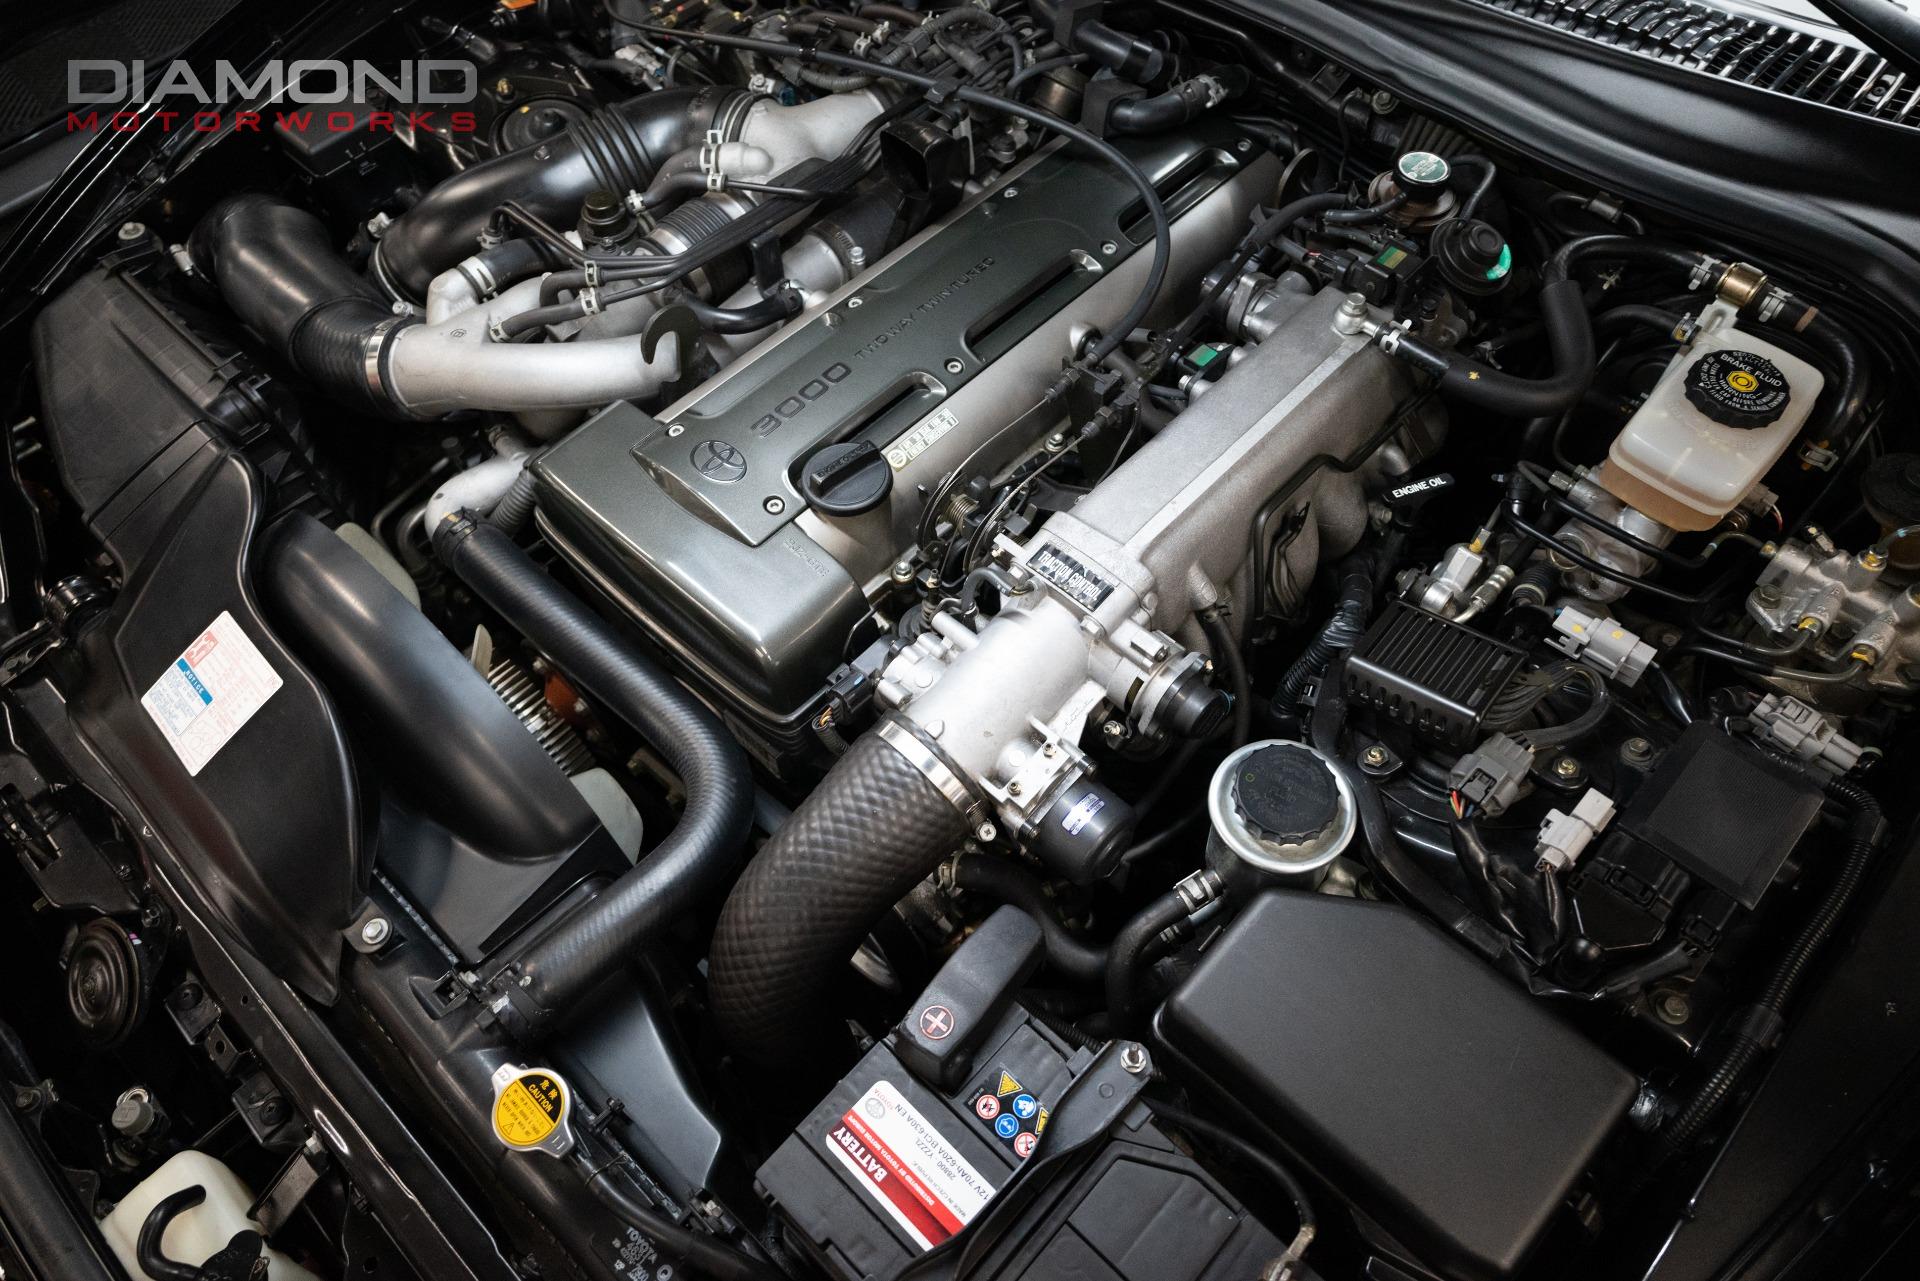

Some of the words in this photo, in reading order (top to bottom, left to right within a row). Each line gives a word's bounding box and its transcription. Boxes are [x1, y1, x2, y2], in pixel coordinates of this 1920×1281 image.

[750, 361, 852, 438] 3000
[918, 288, 951, 314] TWIN
[950, 255, 995, 291] TURBO
[1720, 353, 1753, 372] BRAKE
[1754, 370, 1782, 386] FLUID
[1392, 481, 1430, 498] ENGINE
[1428, 477, 1447, 488] OIL
[1038, 550, 1073, 579] TRACTION
[1069, 572, 1102, 600] CONTROL
[184, 669, 204, 695] NOTICE
[528, 1084, 553, 1113] CAUTION
[539, 1079, 558, 1100] 危険
[895, 1103, 907, 1117] EN
[846, 1113, 866, 1133] EUROPE
[863, 1130, 883, 1150] MOTOR
[833, 1127, 888, 1183] BATTERY
[879, 1147, 900, 1170] TOYOTA
[936, 1159, 957, 1180] 28800
[902, 1173, 935, 1206] DISTRIBUTED
[930, 1180, 949, 1199] CZECH
[974, 1185, 990, 1200] 12V
[945, 1196, 955, 1205] IN
[951, 1203, 967, 1218] MADE
